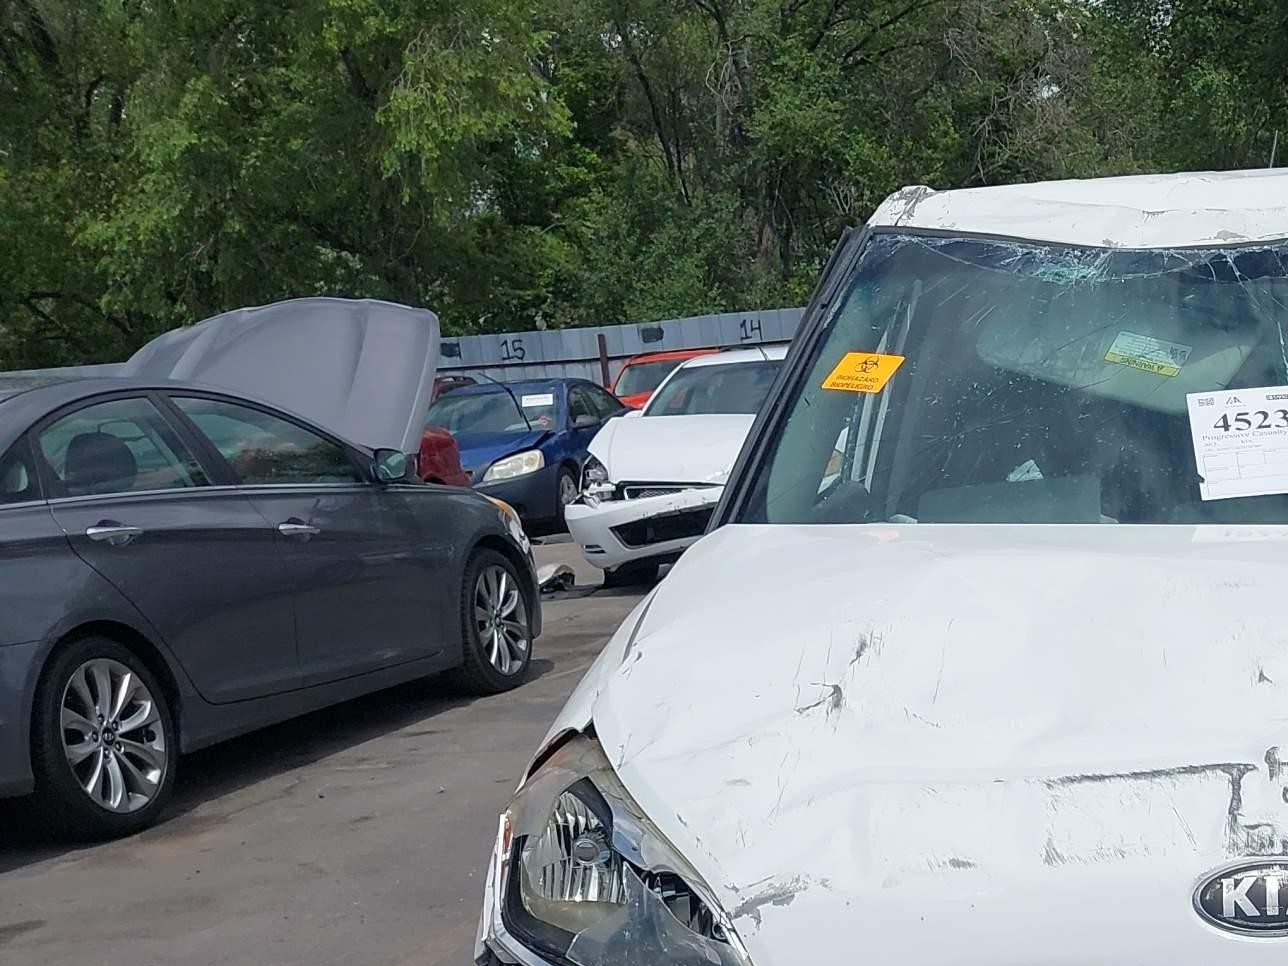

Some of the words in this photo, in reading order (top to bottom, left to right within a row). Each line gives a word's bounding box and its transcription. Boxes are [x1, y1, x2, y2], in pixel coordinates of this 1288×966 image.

[740, 319, 763, 341] 14
[500, 339, 526, 360] 15
[829, 381, 874, 390] BIOPELIGRO
[835, 374, 879, 383] BIOHAZARD
